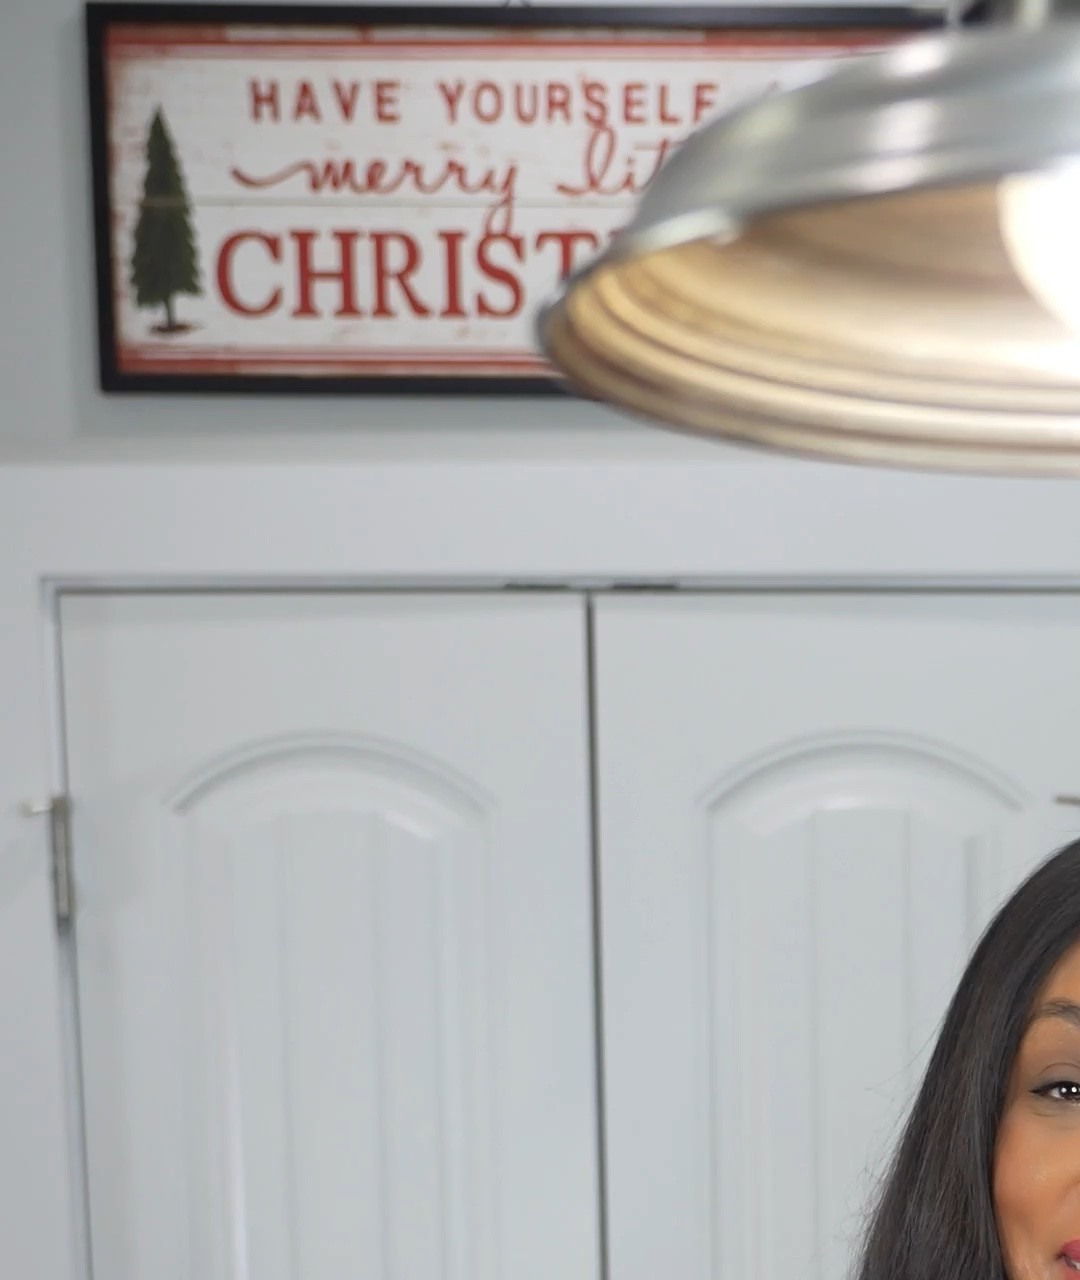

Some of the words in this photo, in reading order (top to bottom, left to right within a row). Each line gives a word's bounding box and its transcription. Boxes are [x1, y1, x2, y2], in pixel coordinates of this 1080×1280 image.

[249, 79, 402, 124] HAVE
[437, 79, 718, 125] YOURSELF
[229, 157, 518, 236] merry
[556, 127, 672, 196] lit
[215, 228, 612, 320] CHRIST
